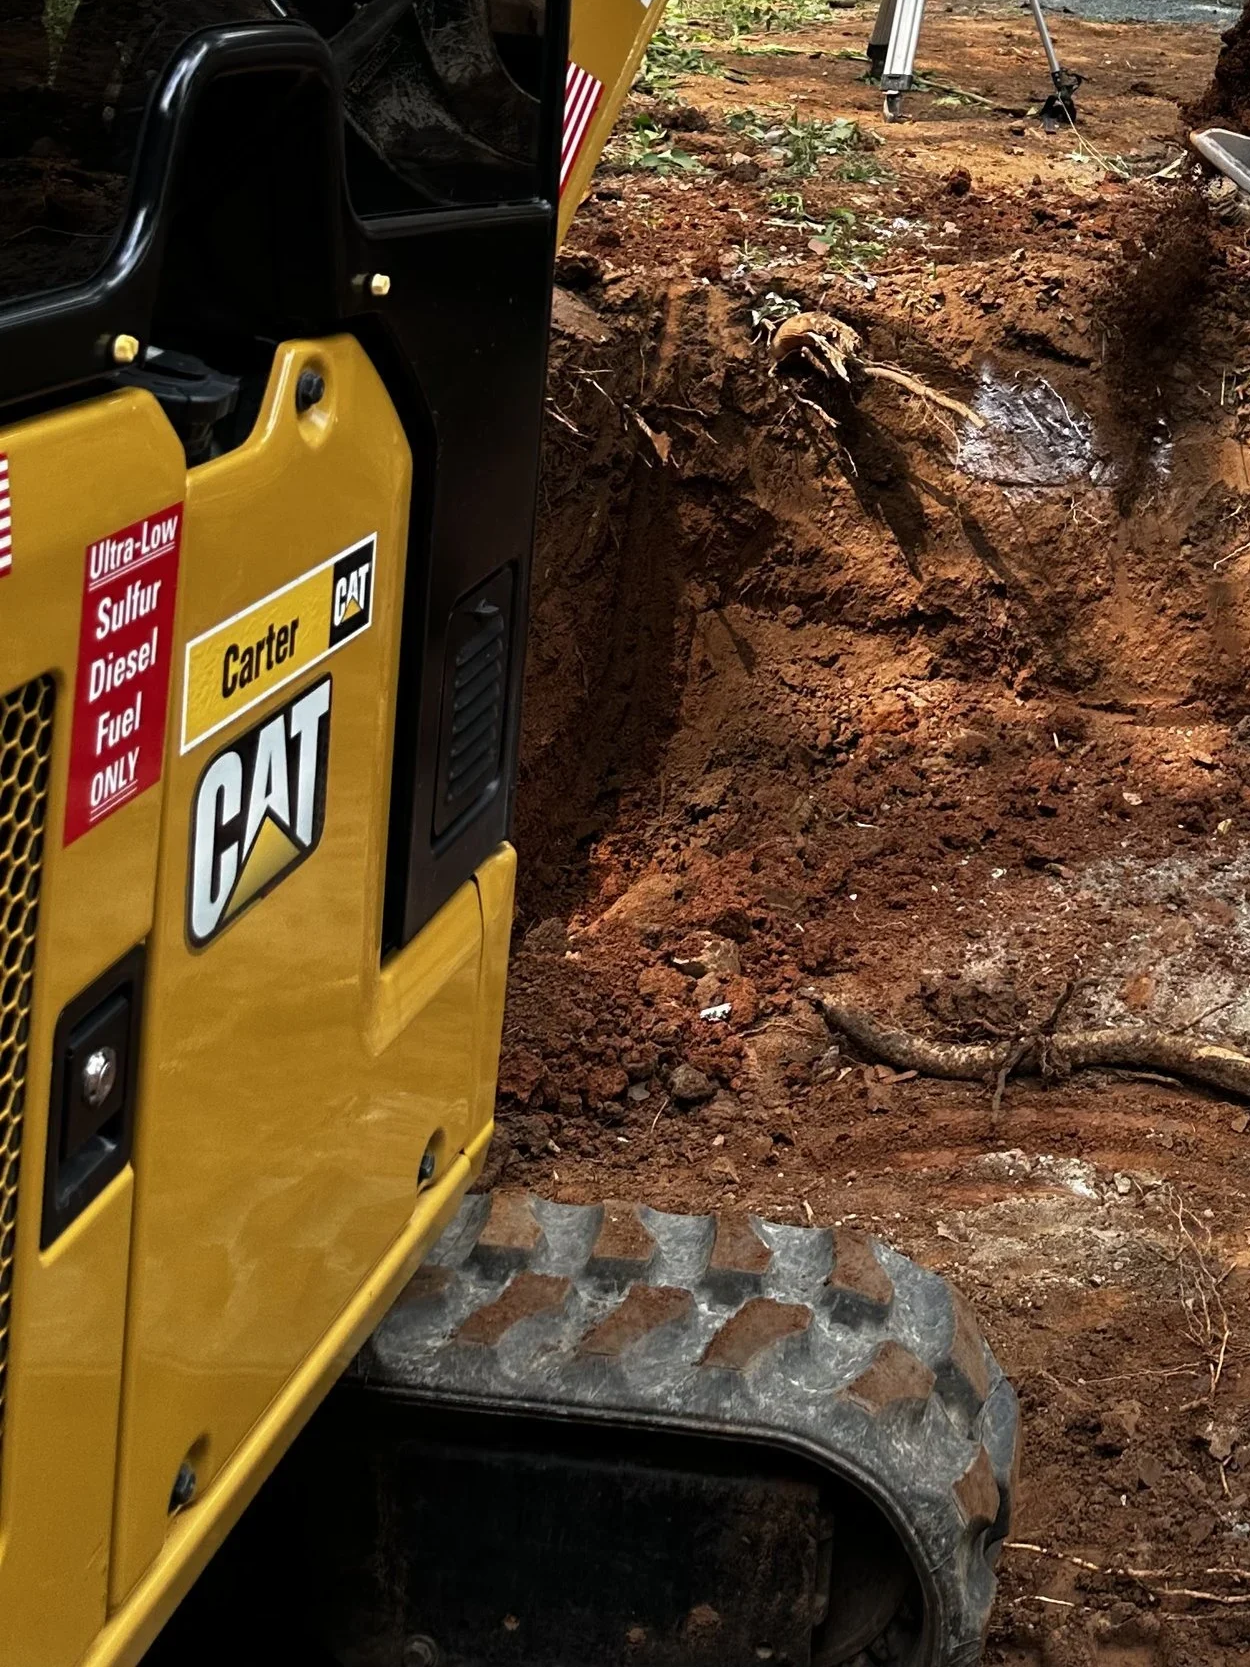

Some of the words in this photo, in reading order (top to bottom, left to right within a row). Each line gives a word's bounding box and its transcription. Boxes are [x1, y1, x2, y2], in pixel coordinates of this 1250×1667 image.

[90, 515, 178, 580] Ultra-Low
[96, 579, 162, 640] Sulfur
[334, 563, 370, 627] CAT
[88, 626, 158, 703] Diesel
[222, 616, 299, 699] Carter
[96, 691, 142, 756] Fuel
[90, 746, 140, 807] ONLY
[192, 679, 331, 938] CAT
